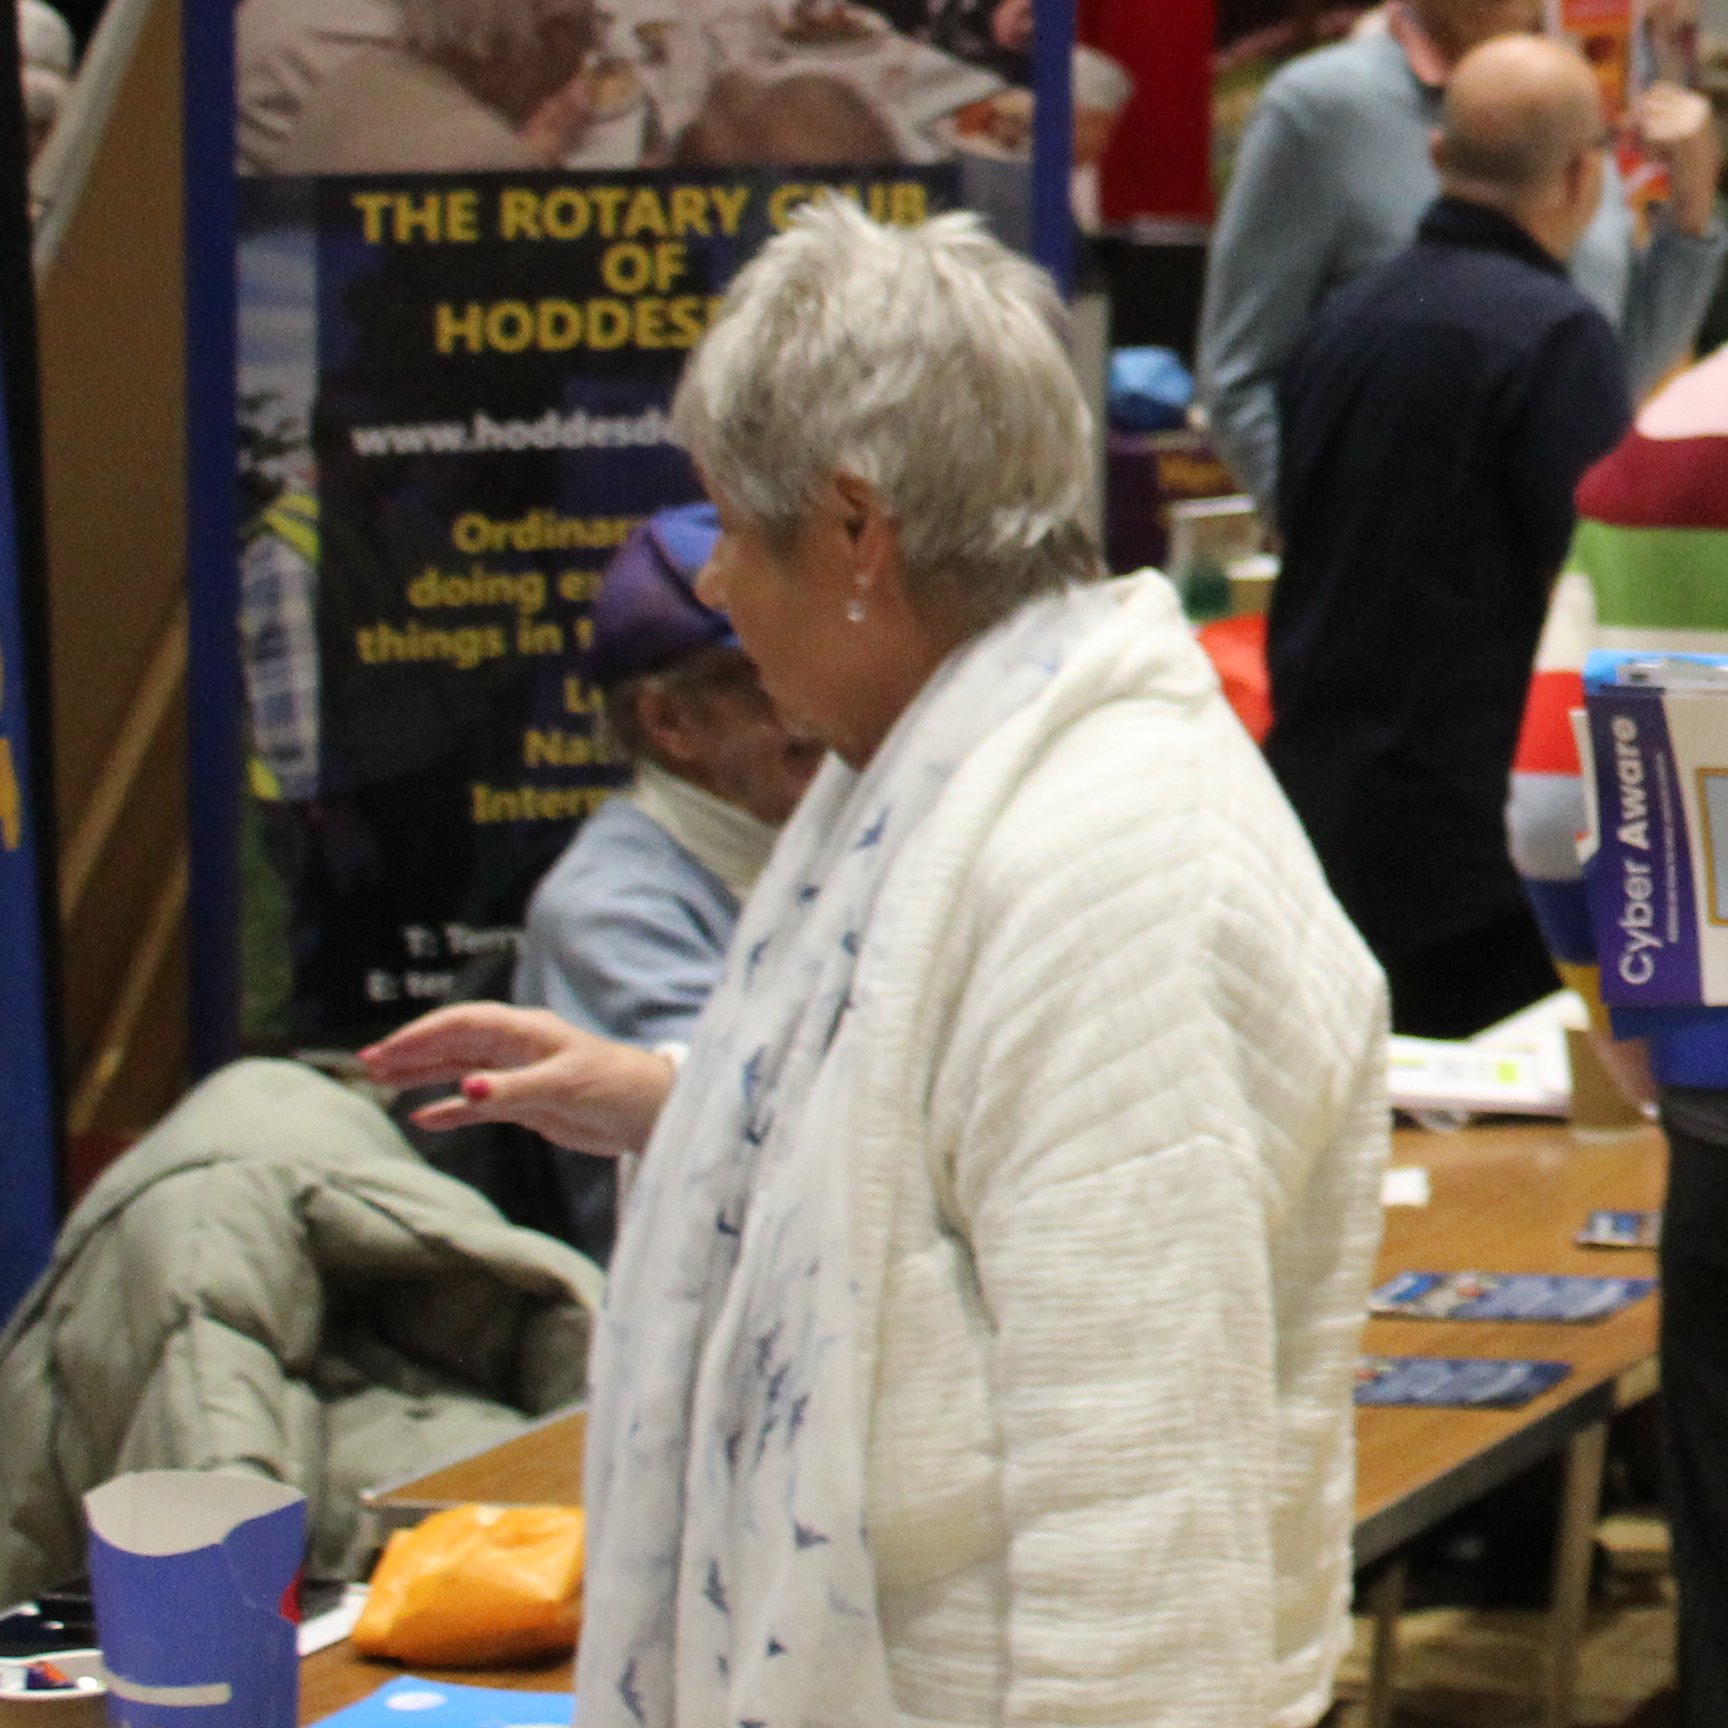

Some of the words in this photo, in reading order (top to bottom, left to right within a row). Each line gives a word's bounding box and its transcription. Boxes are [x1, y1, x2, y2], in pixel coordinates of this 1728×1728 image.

[353, 189, 479, 244] THE
[499, 184, 748, 240] ROTARY
[767, 183, 928, 232] CUB
[602, 239, 687, 294] OF
[434, 294, 724, 355] HODDES
[407, 565, 547, 616] doing
[356, 618, 505, 670] things
[517, 615, 562, 655] in
[1611, 715, 1650, 851] Aware
[1618, 857, 1664, 985] Cyber
